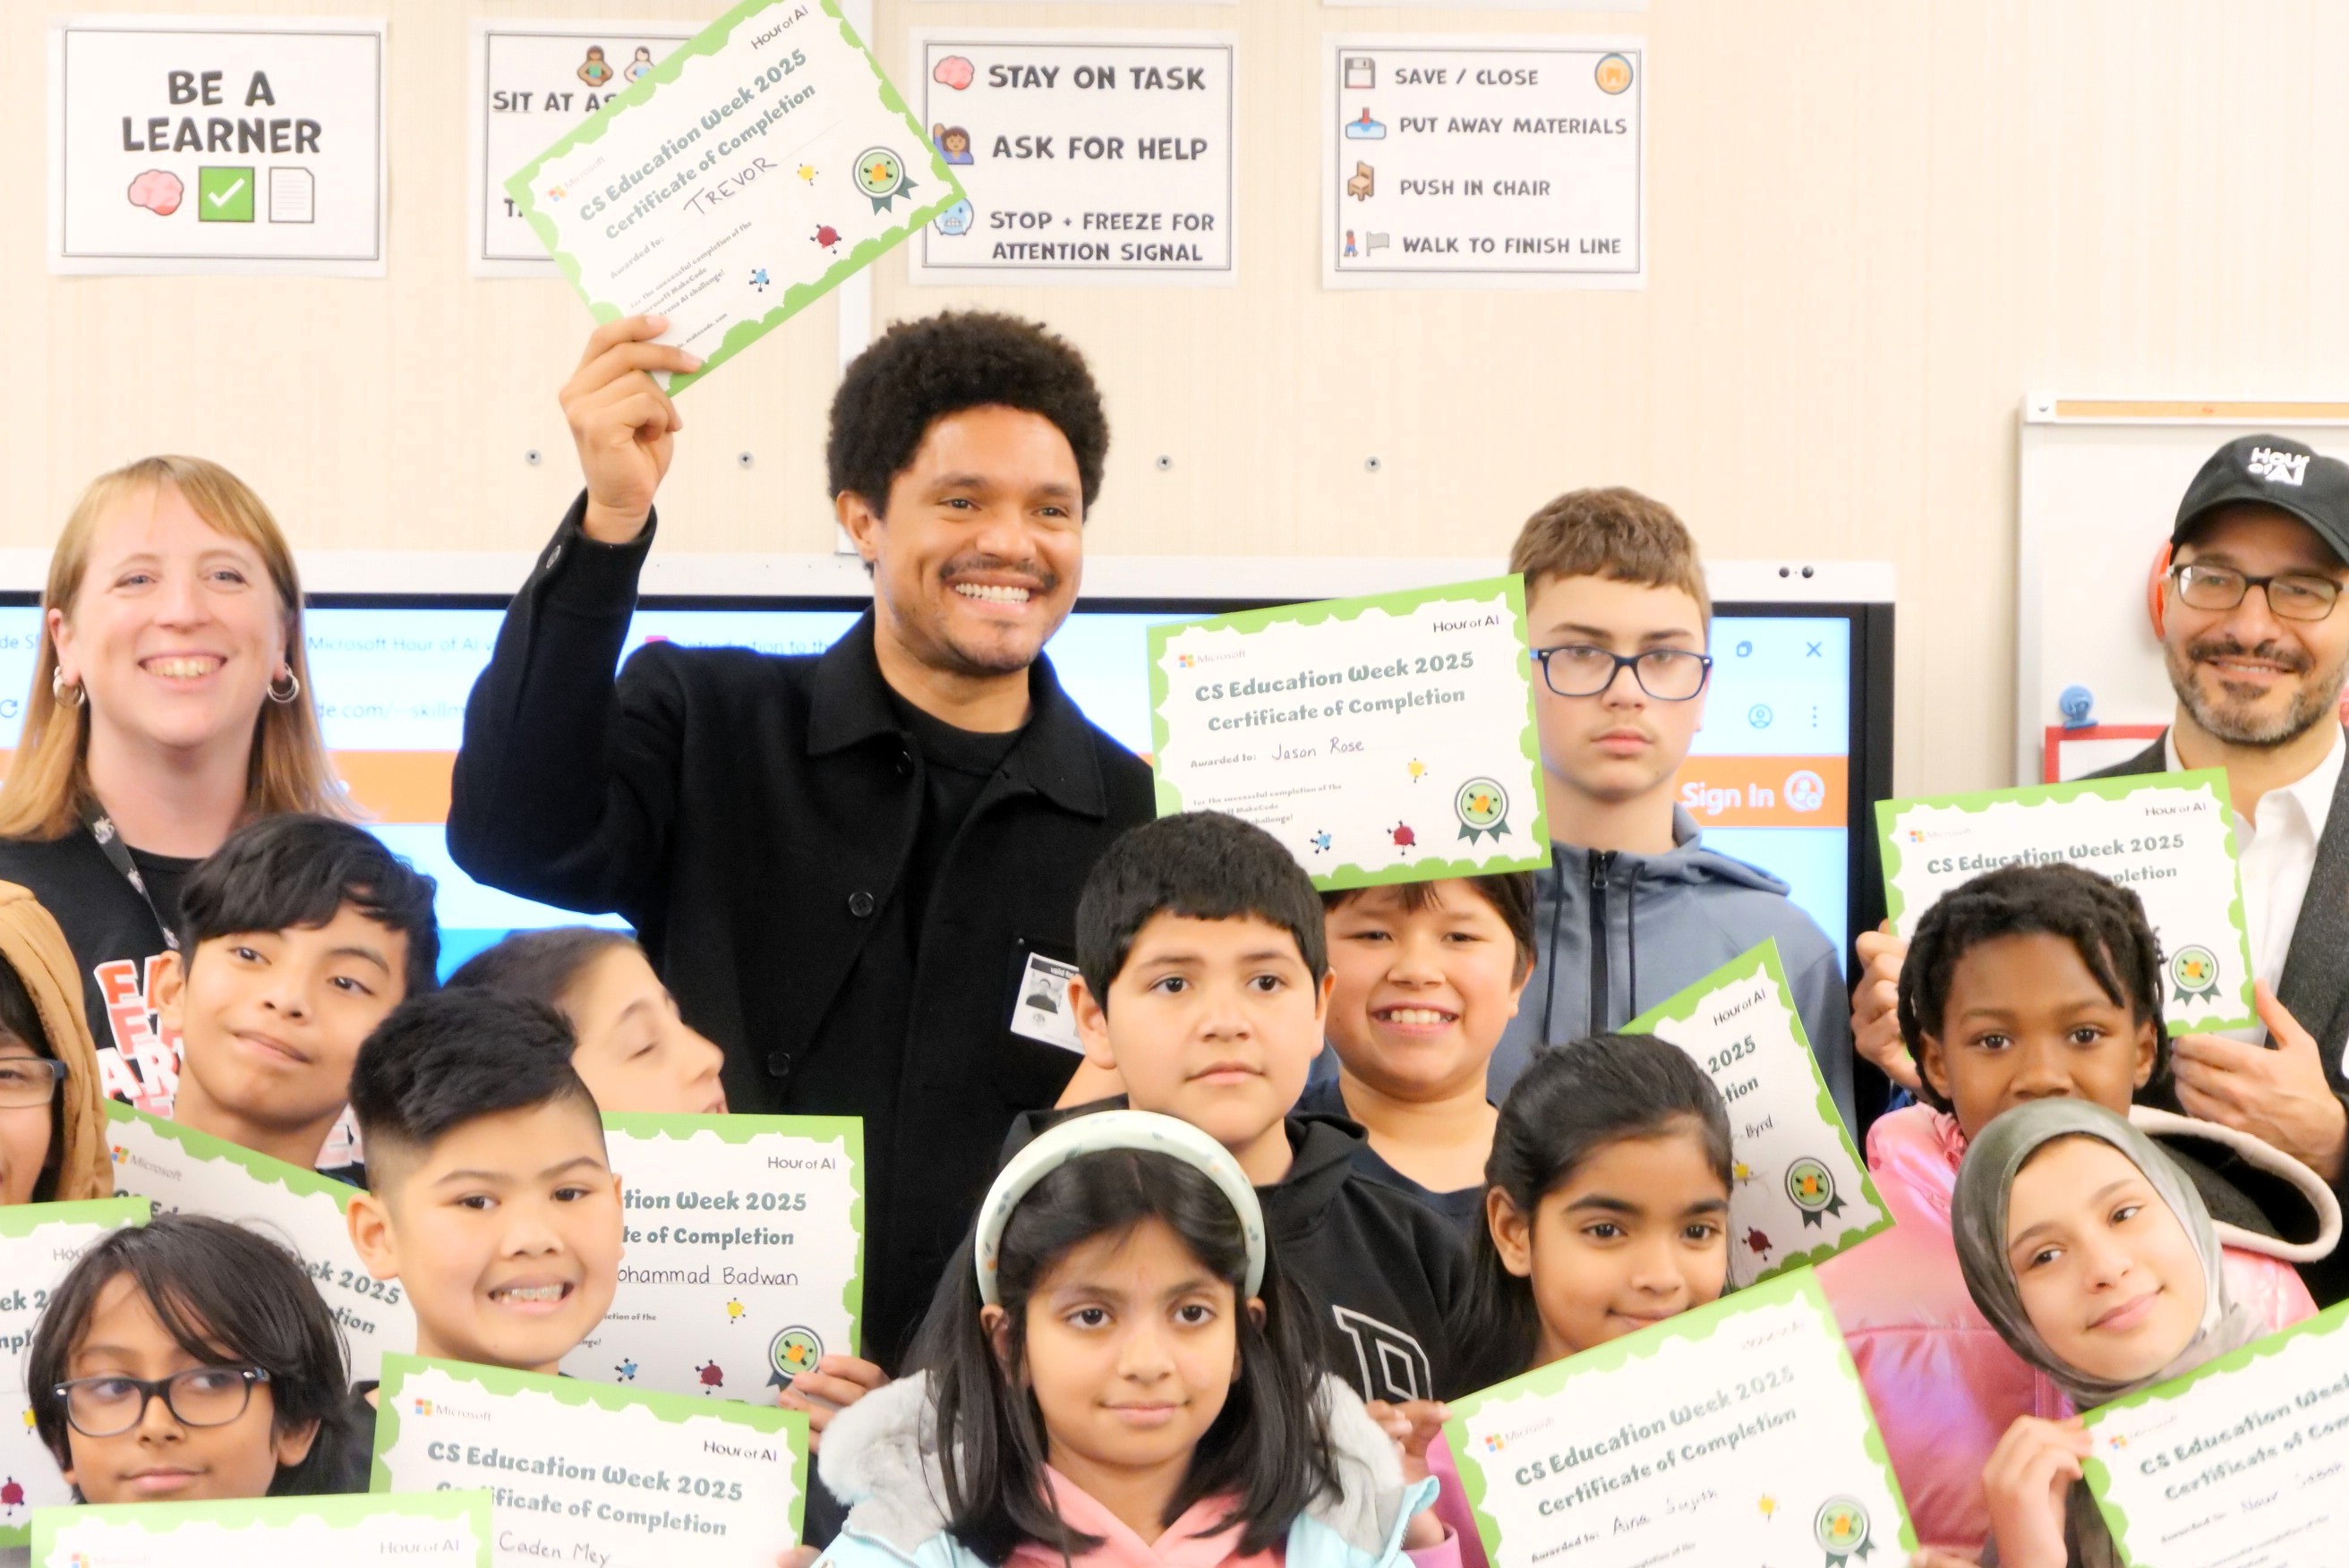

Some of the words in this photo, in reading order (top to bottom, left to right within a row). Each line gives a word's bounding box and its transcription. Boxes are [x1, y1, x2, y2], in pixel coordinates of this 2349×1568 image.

[751, 23, 782, 50] Hour
[795, 4, 808, 21] AI
[168, 70, 223, 106] BE
[244, 70, 276, 107] A
[988, 64, 1060, 89] STAY
[1074, 65, 1116, 89] ON
[1130, 66, 1206, 90] TASK
[1395, 68, 1448, 85] SAVE
[1477, 69, 1539, 86] CLOSE
[492, 90, 534, 111] SIT
[544, 92, 574, 112] AT
[122, 116, 322, 154] LEARNER
[580, 196, 606, 221] CS
[605, 127, 702, 201] Education
[700, 87, 755, 131] Week
[754, 48, 806, 93] 2025
[1399, 117, 1439, 133] PUT
[1447, 118, 1503, 133] AWAY
[1513, 118, 1627, 134] MATERIALS
[992, 135, 1055, 159] ASK
[1069, 137, 1124, 159] FOR
[1138, 137, 1208, 160] HELP
[564, 156, 606, 190] Microsoft
[606, 168, 697, 239] Certificate
[698, 149, 717, 171] of
[717, 85, 816, 156] Completion
[683, 157, 778, 215] TREVOR
[1399, 180, 1455, 196] PUSH
[1464, 180, 1483, 196] IN
[1493, 180, 1550, 196] CHAIR
[990, 211, 1053, 230] STOP
[1083, 212, 1162, 231] FREEZE
[1173, 213, 1215, 232] FOR
[692, 235, 731, 266] completion
[992, 242, 1110, 260] ATTENTION
[1120, 243, 1203, 262] SIGNAL
[1403, 237, 1459, 253] WALK
[1469, 237, 1495, 254] TO
[1505, 237, 1569, 254] FINISH
[1580, 238, 1621, 254] LINE
[610, 244, 650, 279] Awarded
[671, 267, 707, 294] MakeCode
[2251, 447, 2310, 468] Hour
[2265, 464, 2306, 486] AI
[1433, 620, 1466, 633] Hour
[1484, 614, 1499, 626] AI
[308, 636, 387, 652] Microsoft
[394, 637, 433, 652] Hour
[440, 637, 456, 652] of
[462, 637, 478, 652] AI
[1197, 649, 1246, 664] Microsoft
[1195, 683, 1224, 702] CS
[1229, 669, 1343, 698] Education
[1347, 658, 1409, 682] Week
[1414, 651, 1473, 674] 2025
[1208, 704, 1319, 731] Certificate
[1323, 699, 1344, 717] of
[1348, 687, 1465, 714] Completion
[1190, 753, 1239, 769] Awarded
[1271, 743, 1317, 761] Jason
[1329, 736, 1365, 754] Rose
[1269, 785, 1317, 798] completion
[1680, 782, 1740, 815] Sign
[1749, 784, 1774, 807] In
[2145, 806, 2176, 816] Hour
[2192, 802, 2207, 812] AI
[1926, 857, 1953, 874] CS
[2068, 838, 2125, 859] Week
[2130, 832, 2184, 853] 2025
[1713, 1004, 1739, 1026] Hour
[1754, 988, 1767, 1002] AI
[1708, 1034, 1755, 1074] 2025
[1746, 1113, 1773, 1139] Byrd
[130, 1155, 183, 1181] Microsoft
[767, 1156, 804, 1170] Hour
[805, 1159, 818, 1170] of
[820, 1157, 836, 1170] AI
[676, 1190, 740, 1210] Week
[746, 1192, 807, 1212] 2025
[647, 1226, 669, 1243] of
[673, 1227, 794, 1250] Completion
[337, 1269, 401, 1305] 2025
[618, 1265, 710, 1284] ohammad
[722, 1267, 798, 1285] Badwan
[642, 1313, 657, 1321] the
[436, 1404, 491, 1422] Microsoft
[1515, 1460, 1546, 1487] CS
[1549, 1418, 1666, 1474] Education
[1669, 1387, 1732, 1427] Week
[1735, 1365, 1794, 1401] 2025
[704, 1440, 741, 1457] Hour
[761, 1449, 777, 1461] AI
[2140, 1452, 2171, 1477] CS
[2173, 1403, 2291, 1462] Education
[427, 1441, 460, 1462] CS
[466, 1446, 596, 1481] Education
[602, 1465, 671, 1491] Week
[677, 1475, 743, 1502] 2025
[1538, 1462, 1653, 1516] Certificate
[1656, 1447, 1677, 1472] of
[1680, 1407, 1797, 1462] Completion
[2164, 1444, 2278, 1502] Certificate
[2283, 1429, 2302, 1452] of
[568, 1499, 593, 1518] of
[596, 1504, 727, 1535] Completion
[380, 1540, 422, 1555] Hour
[499, 1530, 561, 1559] Caden
[573, 1542, 611, 1568] Mey
[1532, 1535, 1582, 1564] Awarded
